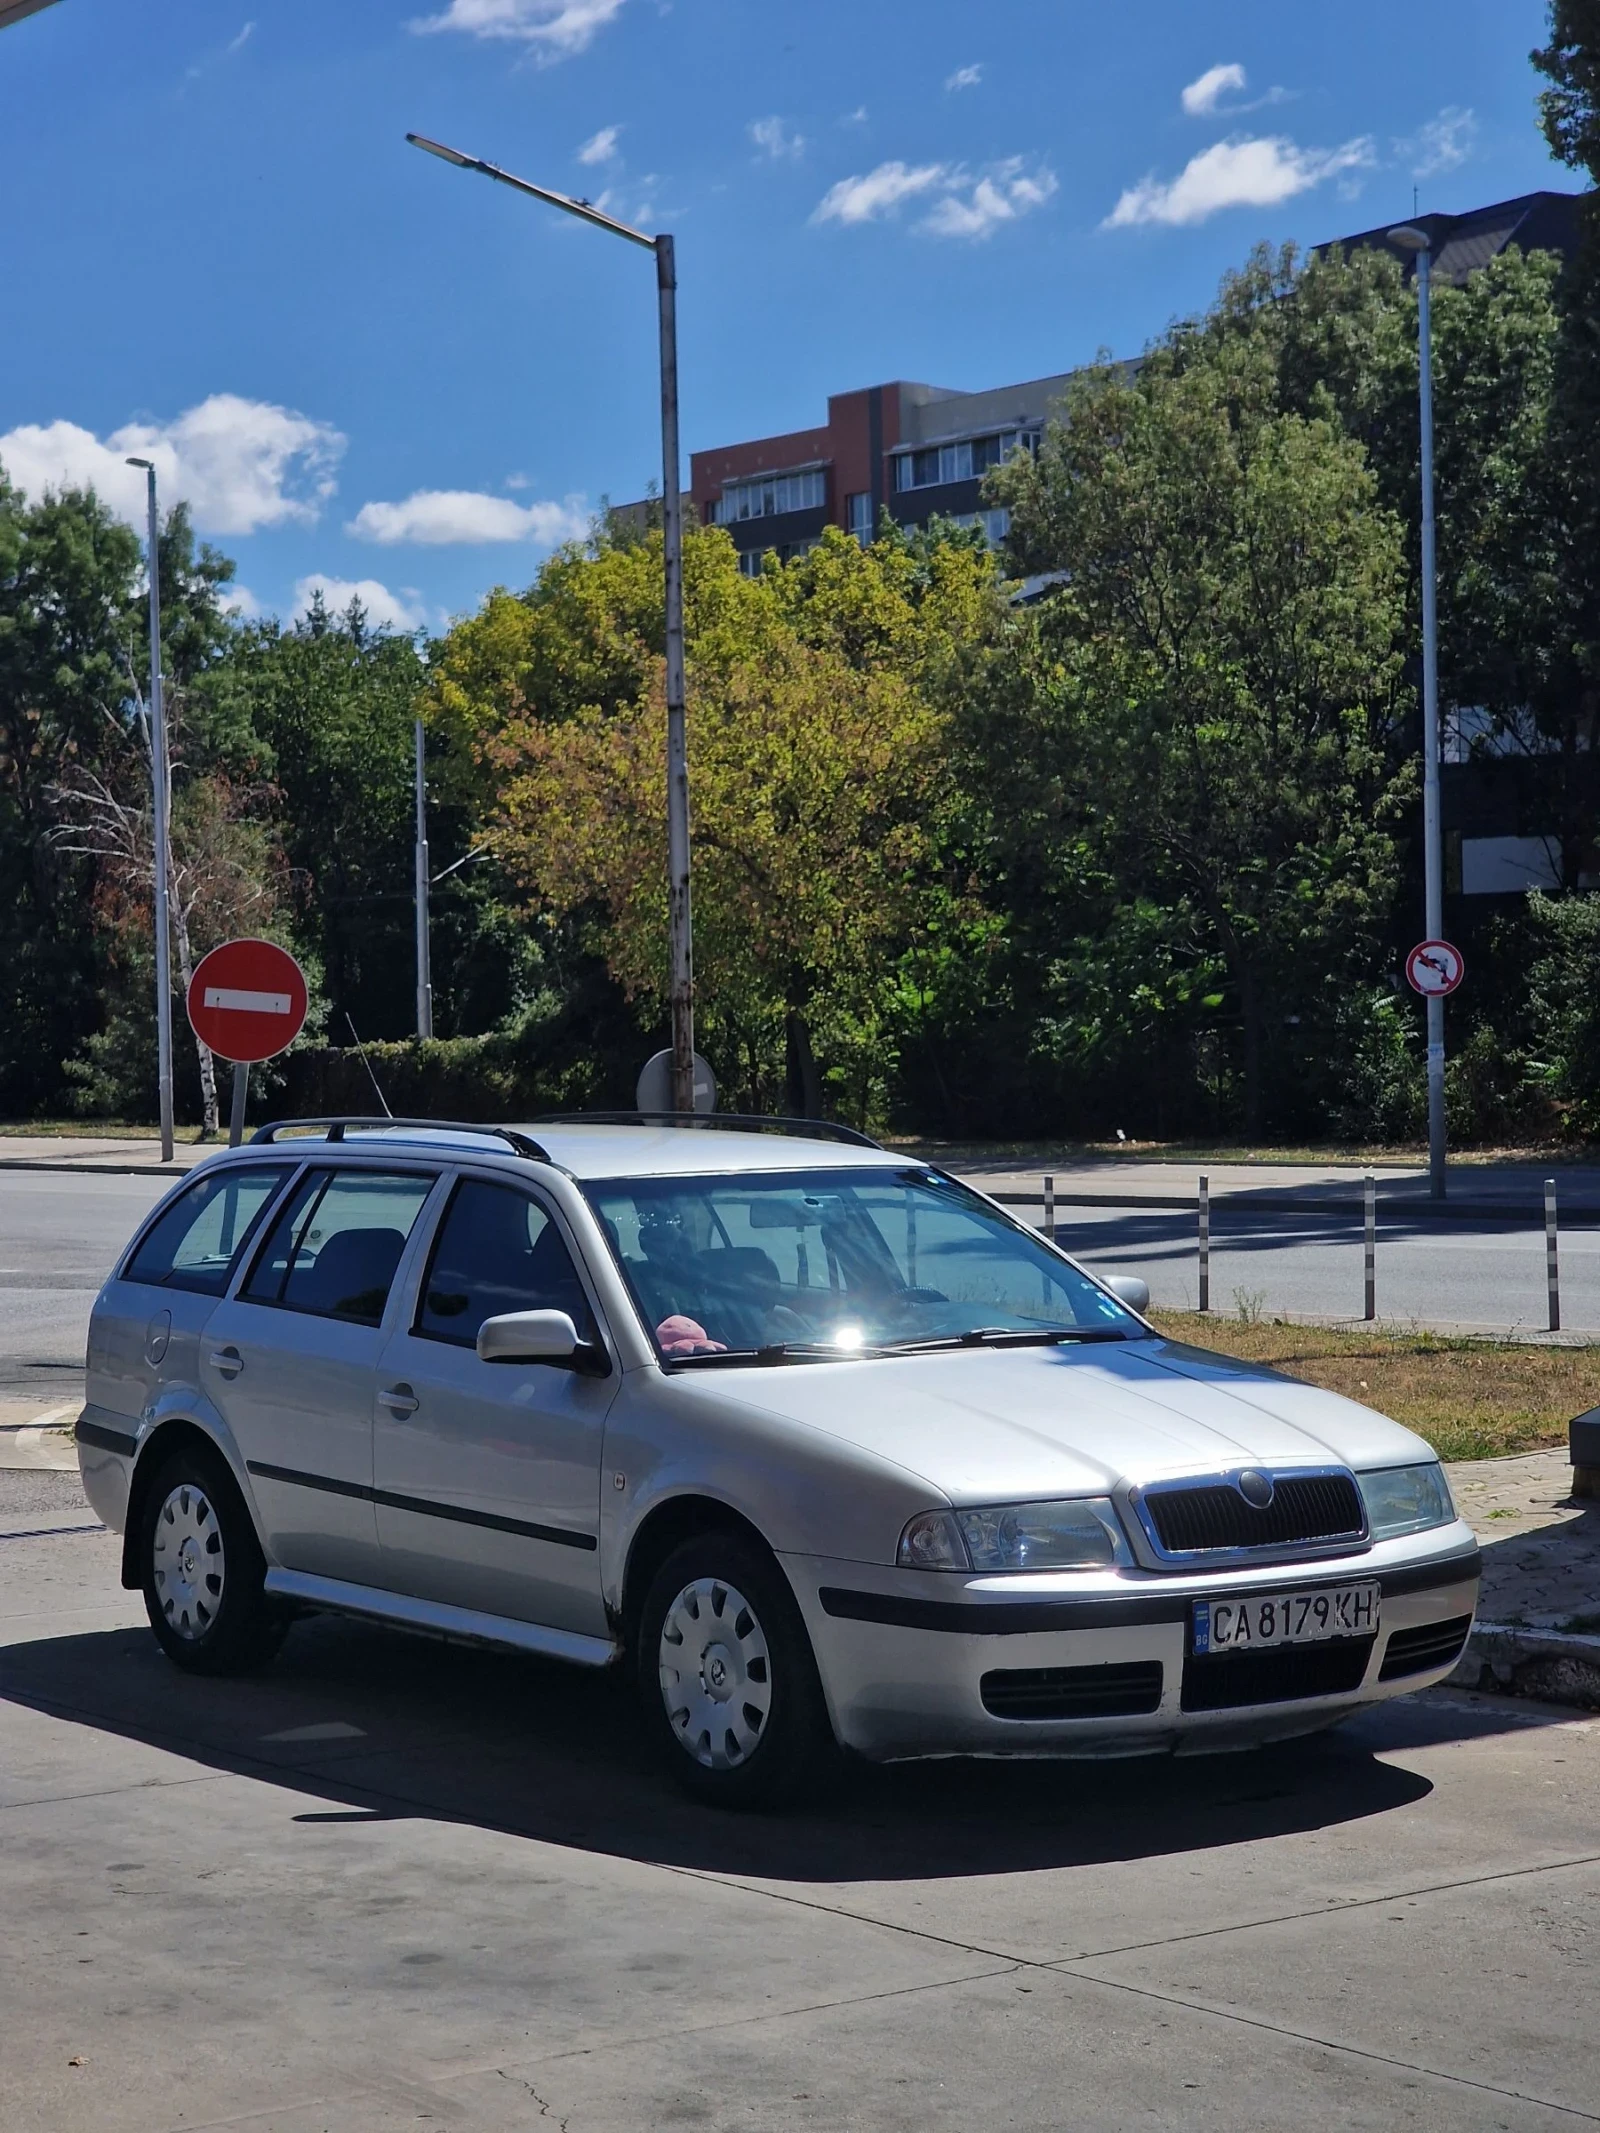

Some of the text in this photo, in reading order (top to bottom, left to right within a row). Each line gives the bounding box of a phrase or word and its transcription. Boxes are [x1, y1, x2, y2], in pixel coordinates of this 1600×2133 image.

[1213, 1590, 1372, 1644] CA 8179 KH
[1195, 1634, 1208, 1647] BG
